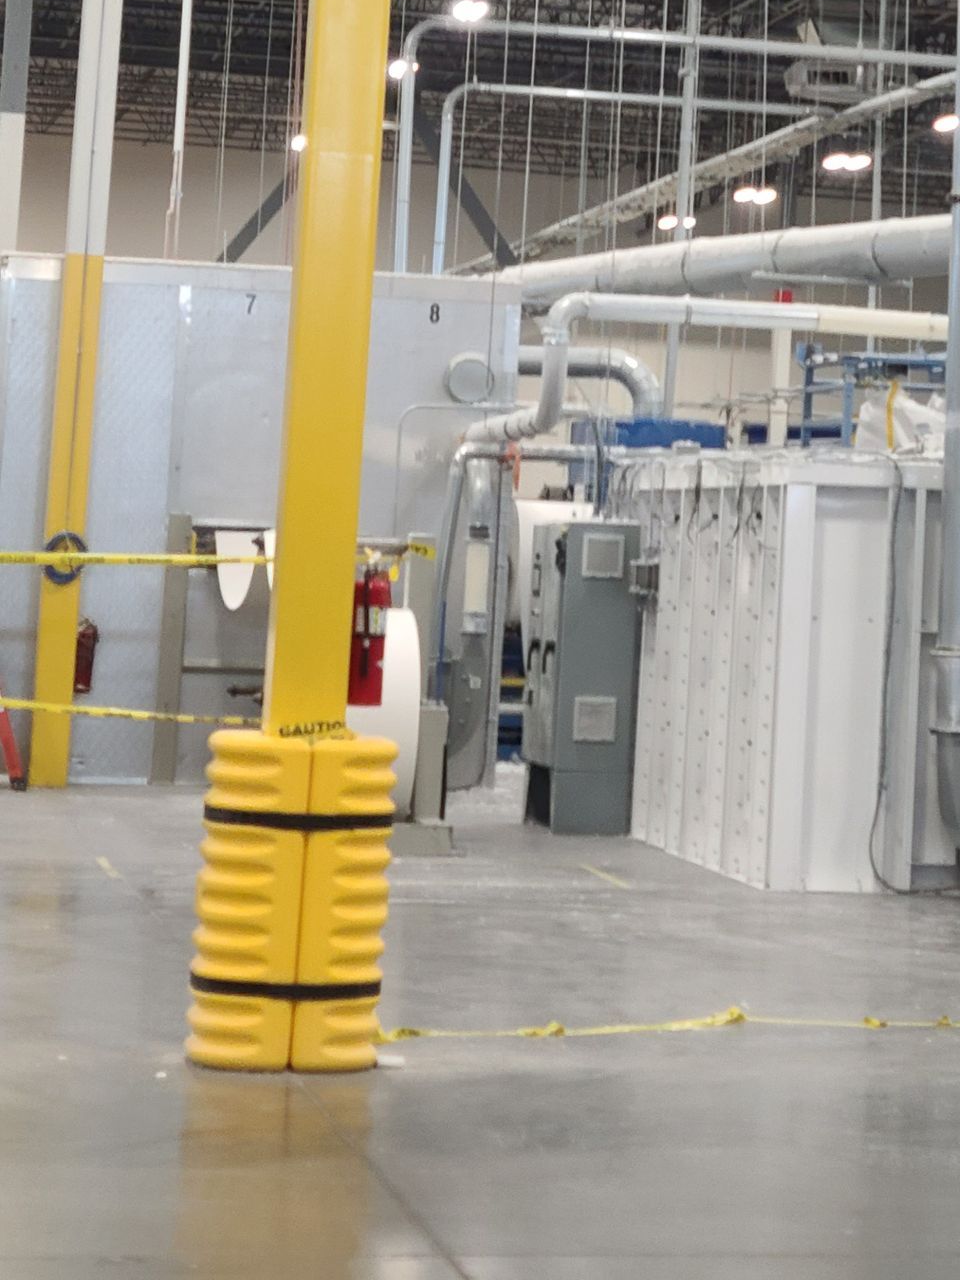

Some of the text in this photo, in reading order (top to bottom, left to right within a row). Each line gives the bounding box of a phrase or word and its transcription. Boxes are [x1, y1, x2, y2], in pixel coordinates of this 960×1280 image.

[245, 293, 256, 315] 7
[429, 302, 440, 324] 8
[279, 721, 346, 738] CAUTIO
